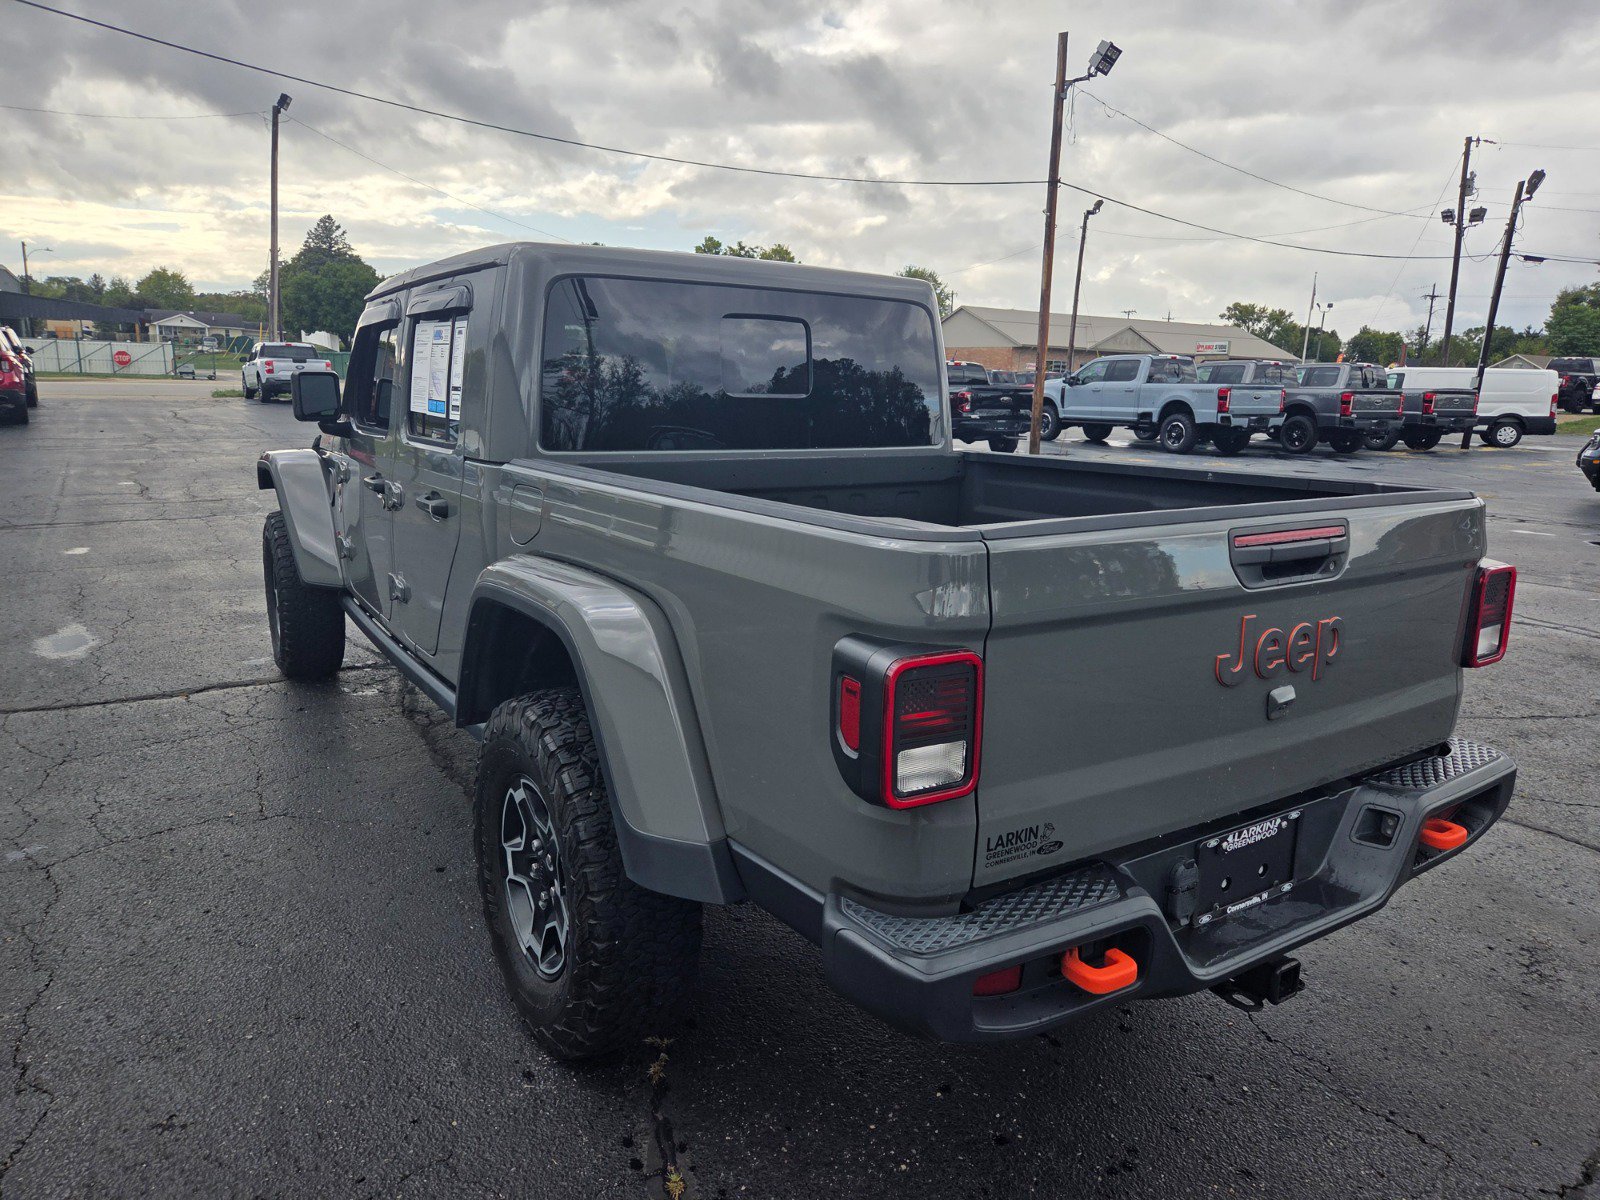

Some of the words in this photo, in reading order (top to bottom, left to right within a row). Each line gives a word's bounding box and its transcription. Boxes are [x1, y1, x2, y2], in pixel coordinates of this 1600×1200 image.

[1214, 614, 1344, 687] Jeep
[986, 825, 1039, 852] LARKIN
[1226, 828, 1278, 852] GREENEWOOD
[1234, 820, 1276, 842] LARKIN
[984, 853, 1029, 868] CONNERSVILLE,
[1029, 849, 1037, 857] IN
[986, 841, 1038, 860] GREENEWOOD
[1261, 891, 1268, 901] IN
